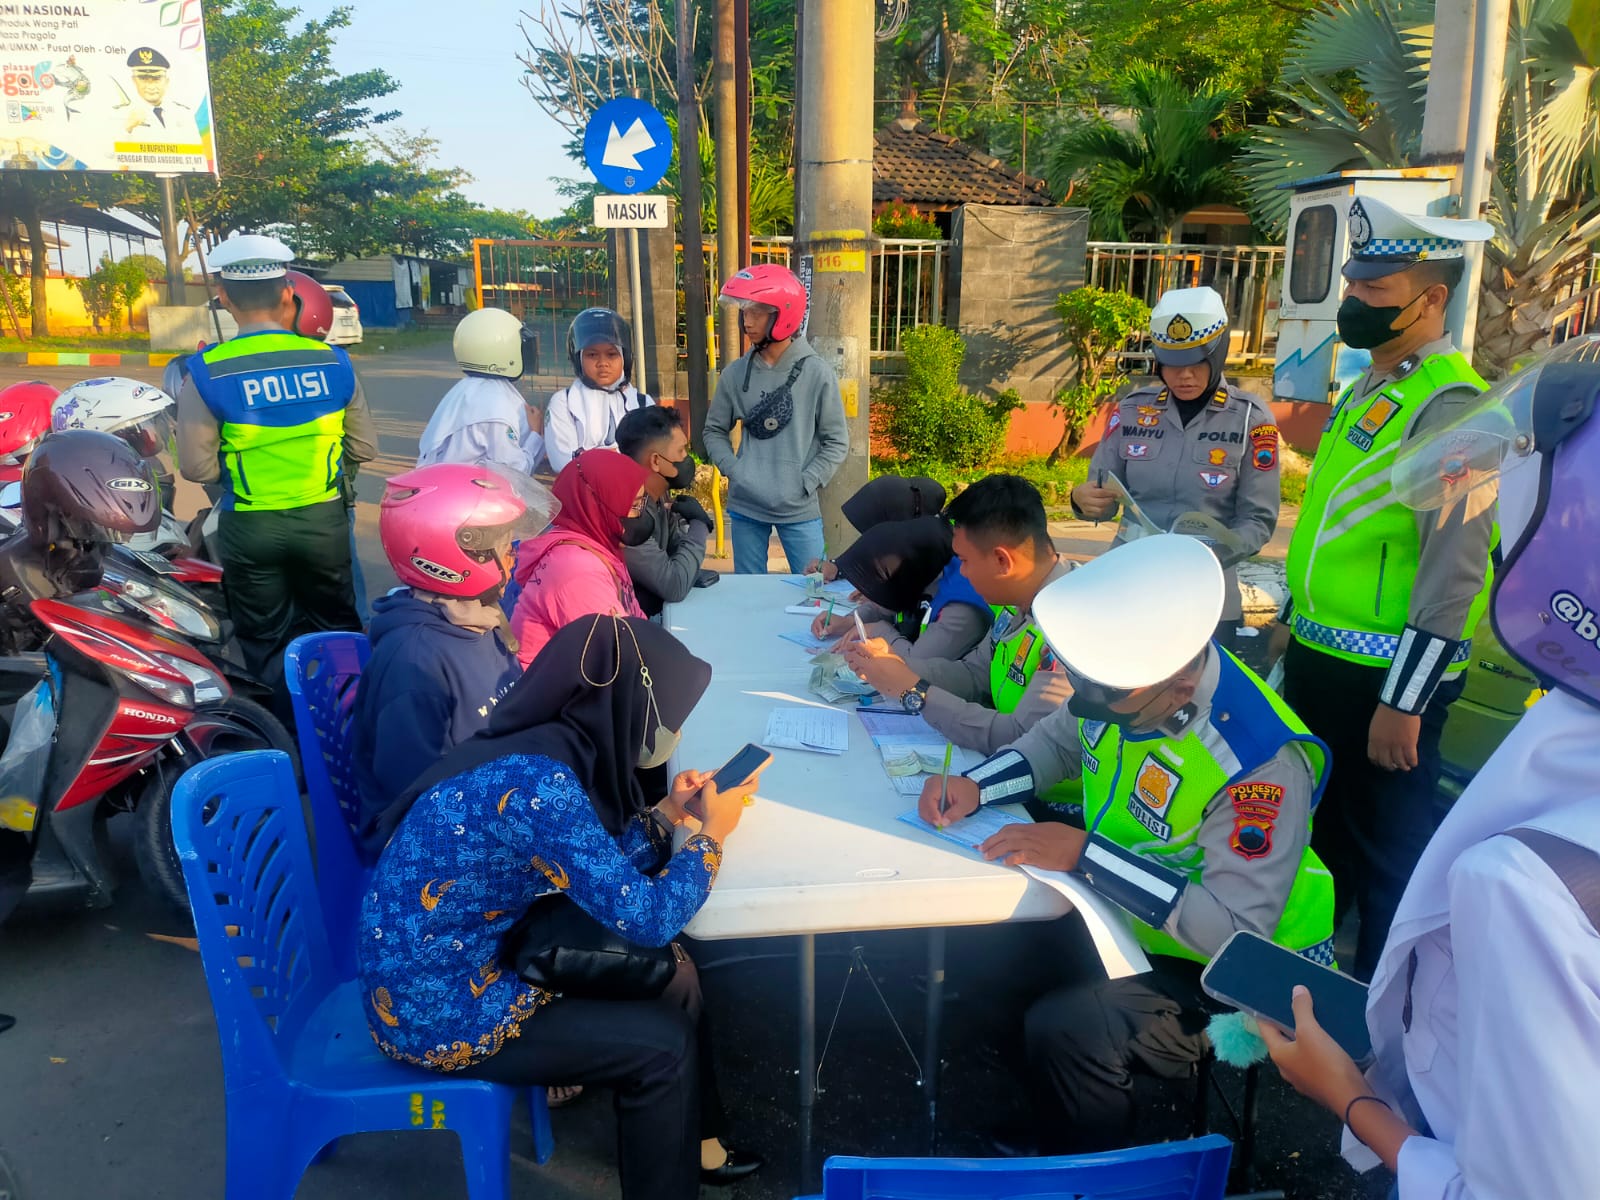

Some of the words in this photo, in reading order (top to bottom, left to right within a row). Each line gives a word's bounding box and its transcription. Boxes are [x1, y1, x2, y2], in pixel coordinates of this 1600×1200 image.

[23, 5, 90, 17] NASIONAL
[62, 20, 79, 29] Pati
[47, 44, 71, 52] Pusat
[73, 45, 96, 53] Oleh
[104, 46, 127, 54] Oleh
[19, 88, 40, 96] baru
[607, 203, 658, 220] MASUK
[817, 255, 842, 269] 116
[242, 370, 330, 406] POLISI
[1122, 425, 1164, 440] WAHYU
[1198, 431, 1244, 444] POLRI
[1348, 430, 1371, 450] POLRI
[415, 559, 459, 579] INK
[1551, 591, 1600, 650] @b
[123, 707, 177, 725] HONDA
[1230, 784, 1282, 797] POLRESTA
[1240, 792, 1276, 801] PATI
[1129, 801, 1167, 837] POLISI
